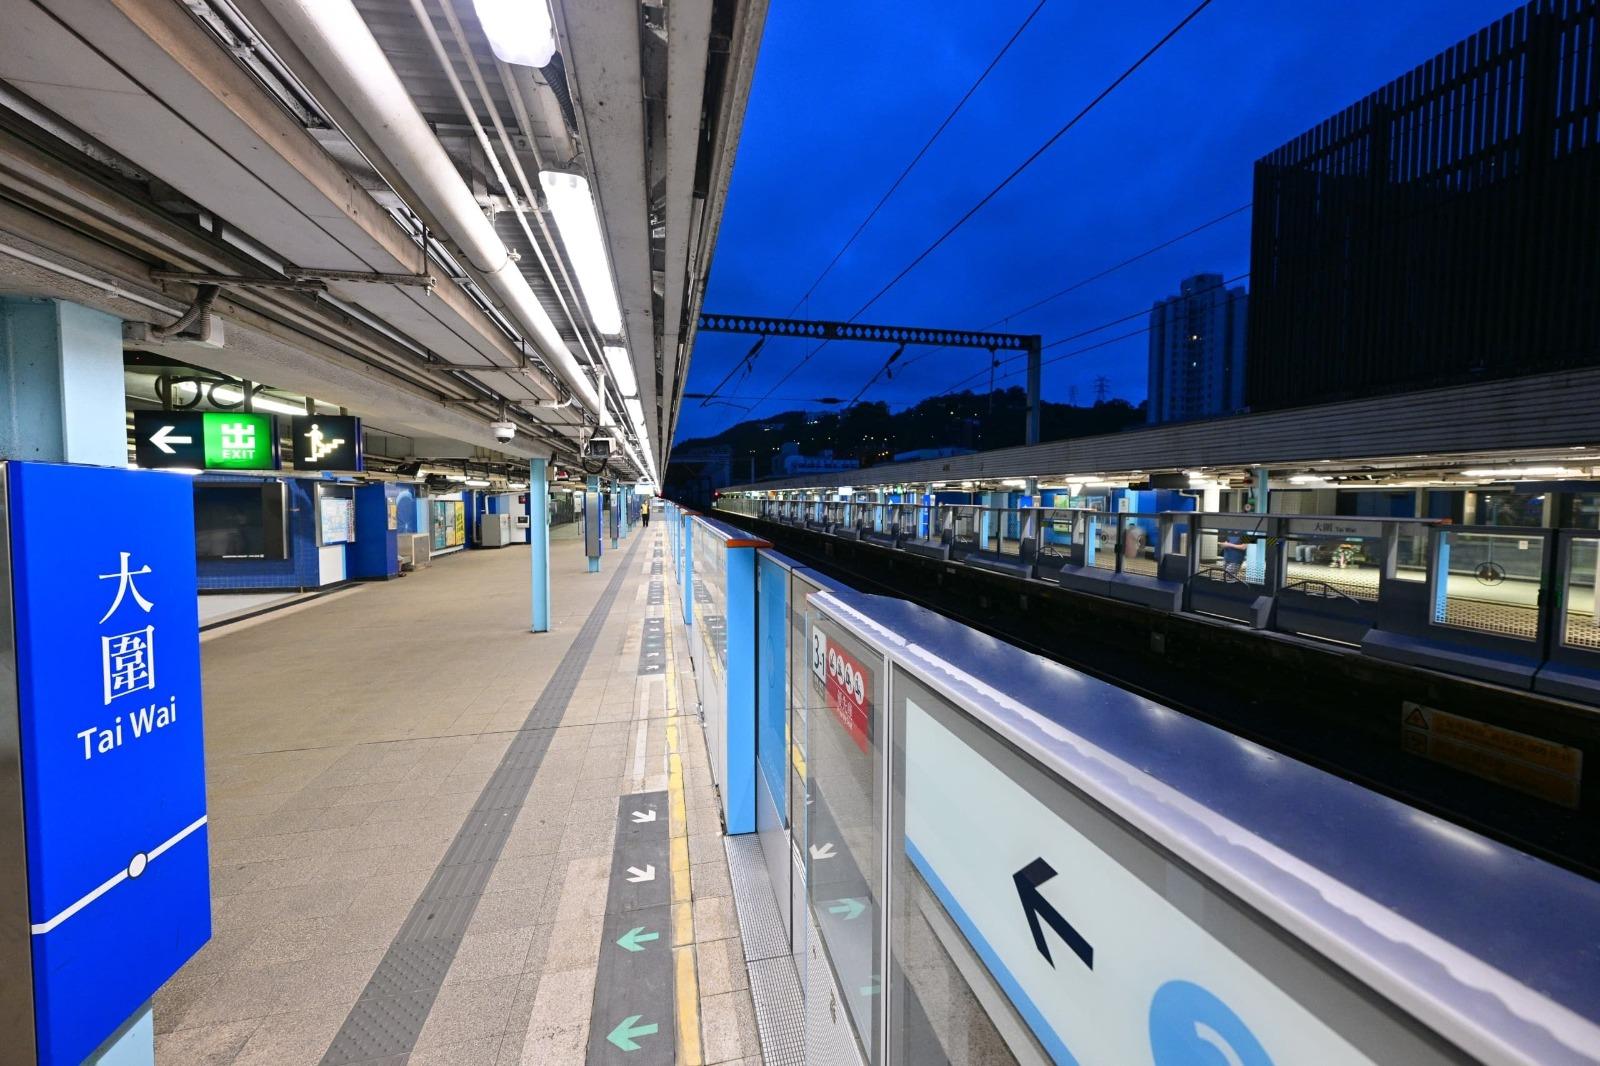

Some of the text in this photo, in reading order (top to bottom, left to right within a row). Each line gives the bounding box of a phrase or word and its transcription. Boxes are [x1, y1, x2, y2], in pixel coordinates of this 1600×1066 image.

[221, 449, 256, 461] EXIT
[98, 551, 156, 706] 大圍
[814, 634, 825, 677] 3-1
[76, 695, 177, 761] Tai Wai
